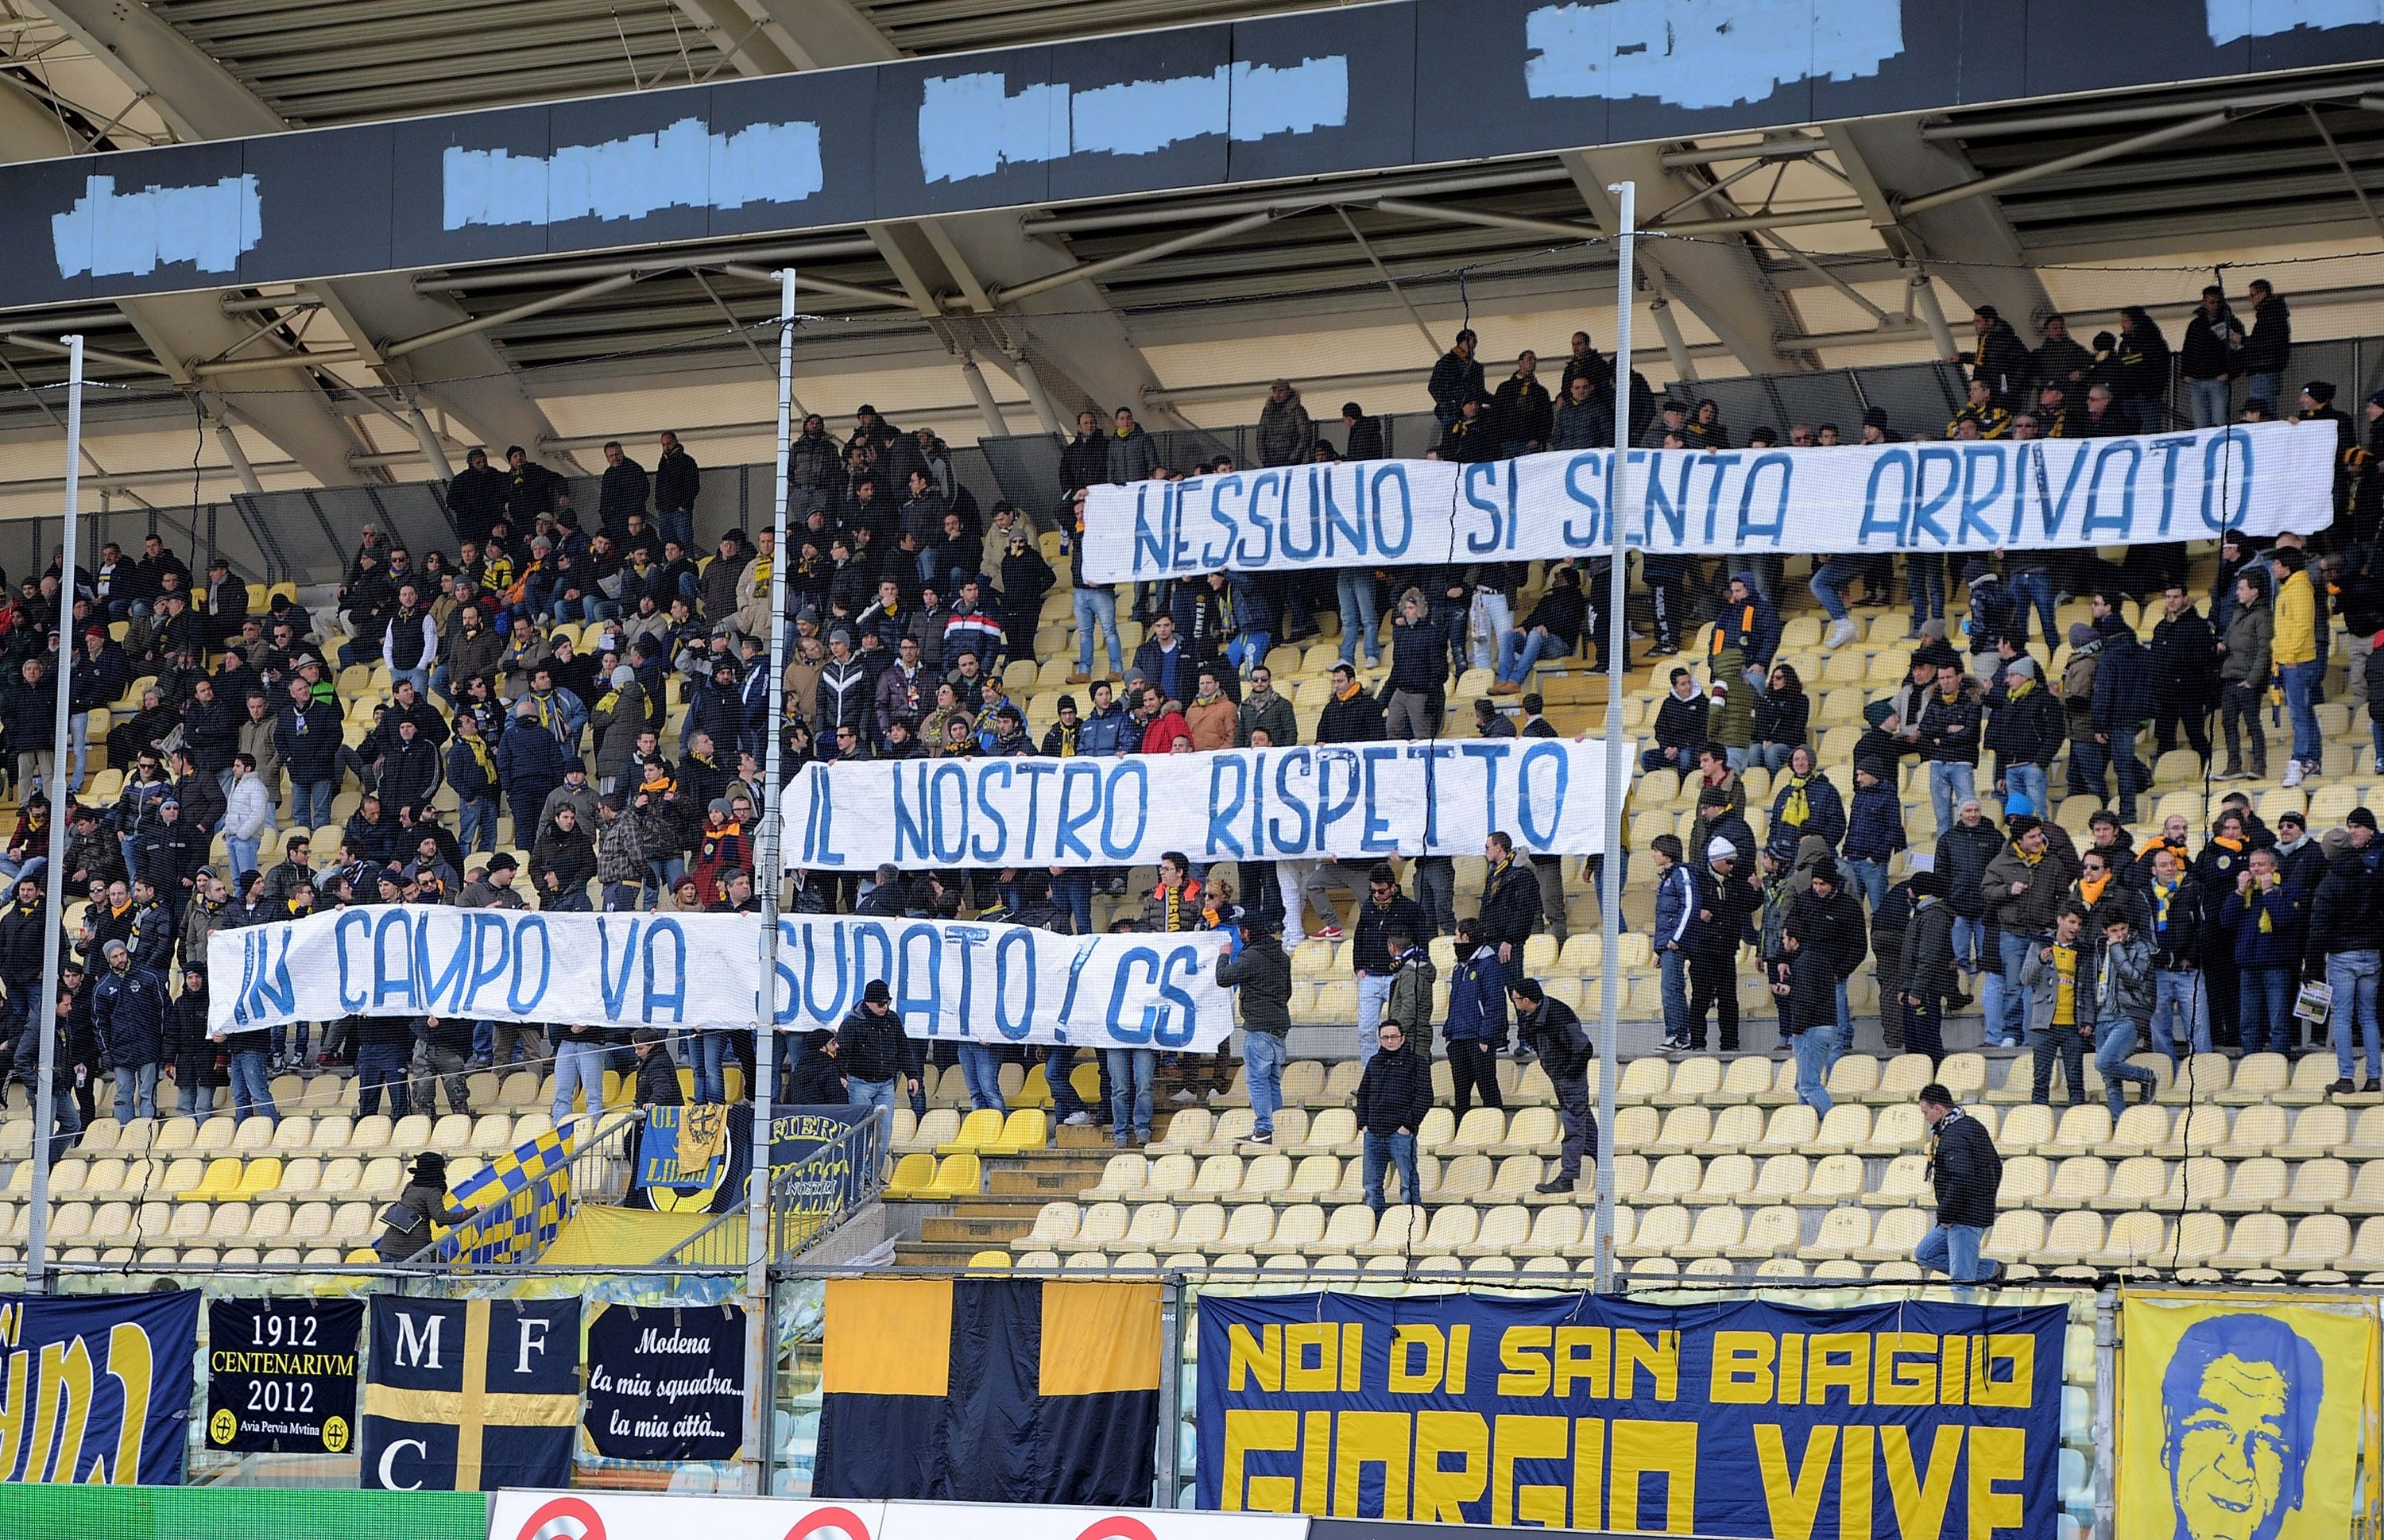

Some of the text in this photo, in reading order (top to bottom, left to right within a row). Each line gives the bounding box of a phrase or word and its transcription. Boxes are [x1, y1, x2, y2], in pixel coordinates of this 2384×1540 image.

[1132, 427, 2255, 576] NESSUNO SI SENTA ARRIVATO
[801, 741, 1569, 865] IL NOSTRO RISPETTO
[235, 926, 296, 1024] IN
[335, 908, 551, 1015] CAMPO
[597, 915, 687, 1023] VA
[1105, 945, 1199, 1047] CS
[251, 1315, 317, 1346] 1912
[394, 1312, 549, 1373] M F
[635, 1326, 710, 1355] Modena
[211, 1351, 354, 1376] CENTENARIVM
[590, 1364, 745, 1404] la mia squadra...
[1228, 1321, 2035, 1408] NOI DI SAN BIAGIO
[248, 1379, 314, 1413] 2012
[240, 1420, 260, 1432] Avia
[261, 1421, 288, 1434] Pervia
[610, 1409, 631, 1436] la
[634, 1418, 669, 1437] mia
[378, 1439, 427, 1490] C
[1220, 1410, 2026, 1540] GIORGIO VIVE
